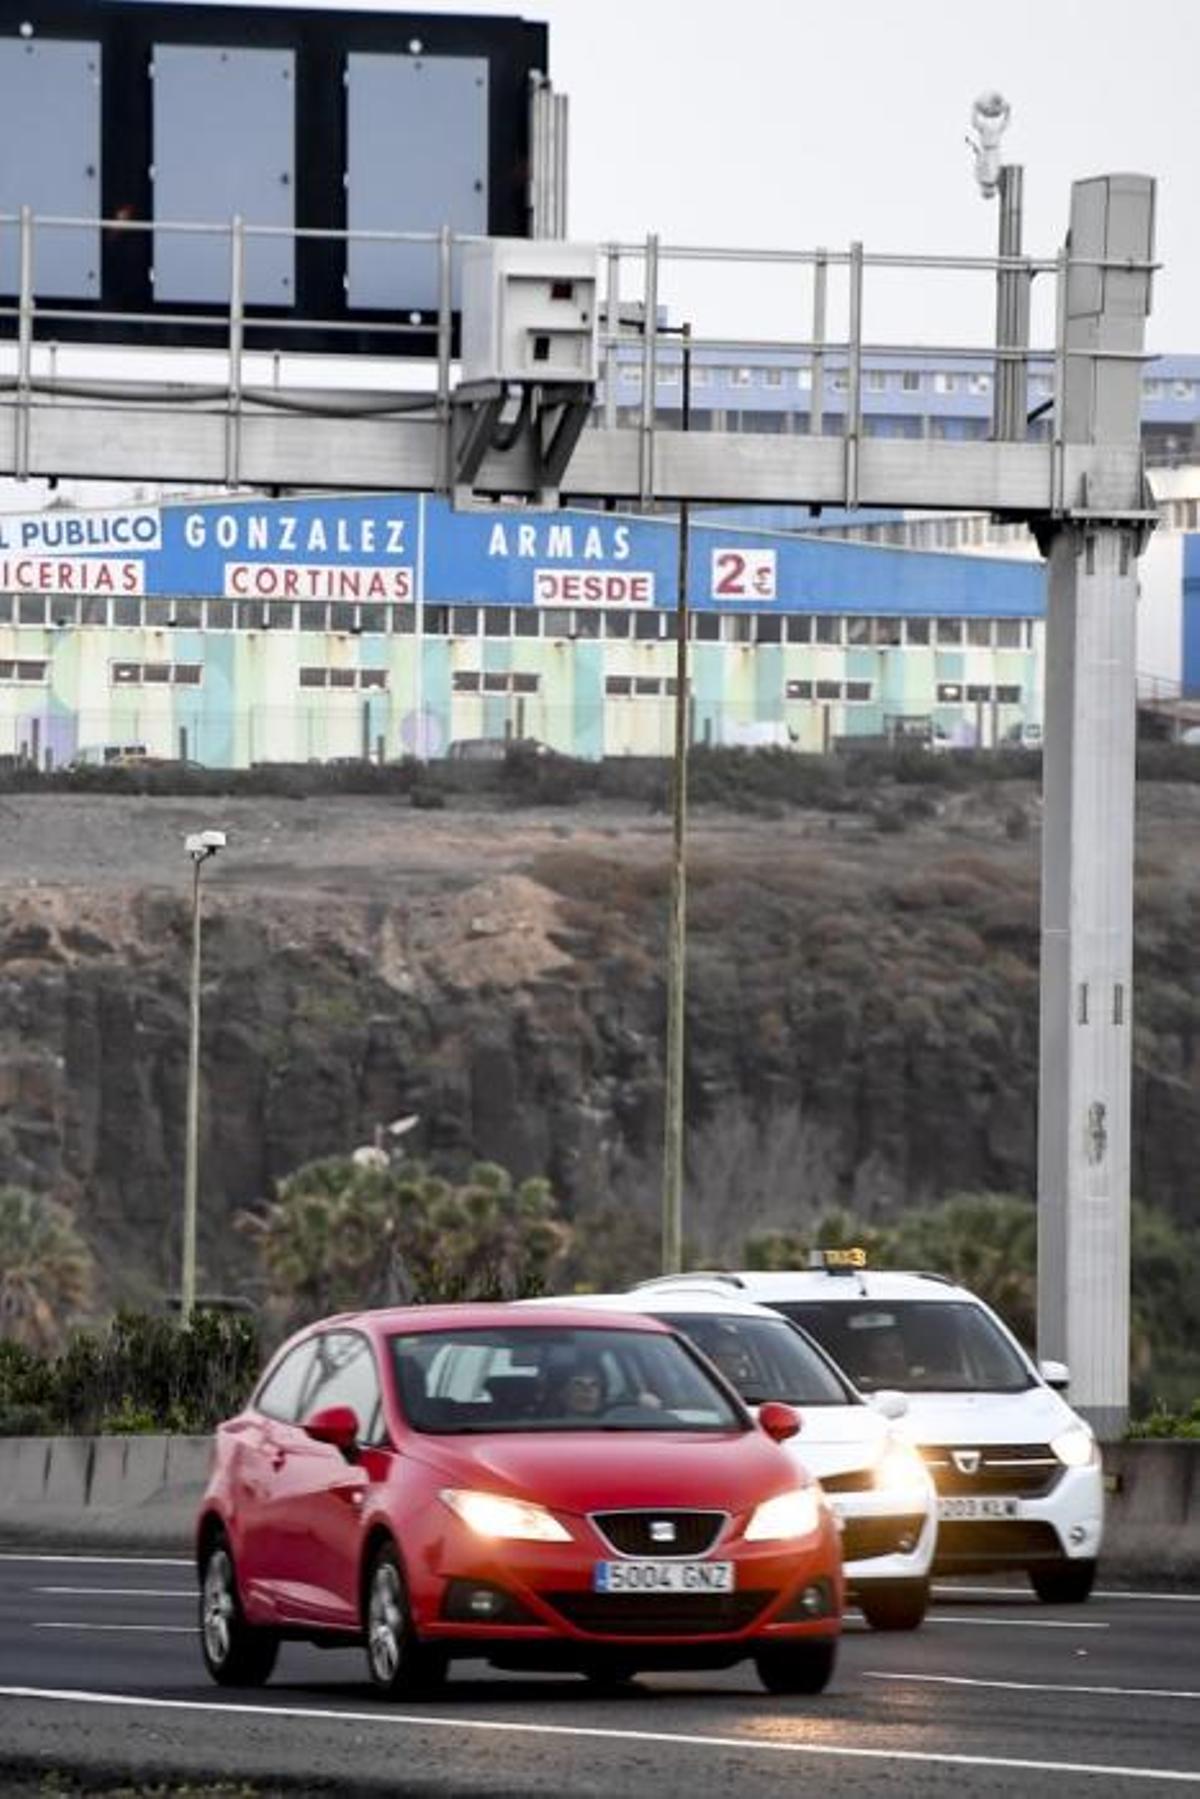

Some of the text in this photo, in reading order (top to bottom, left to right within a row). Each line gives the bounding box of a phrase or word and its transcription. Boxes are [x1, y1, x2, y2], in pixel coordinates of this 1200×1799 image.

[22, 516, 157, 548] PUBLICO
[185, 514, 631, 560] GONZALEZ ARMAS
[3, 561, 138, 591] ICERIAS
[232, 567, 410, 597] CORTINAS
[611, 1565, 728, 1588] 5004 GNZ
